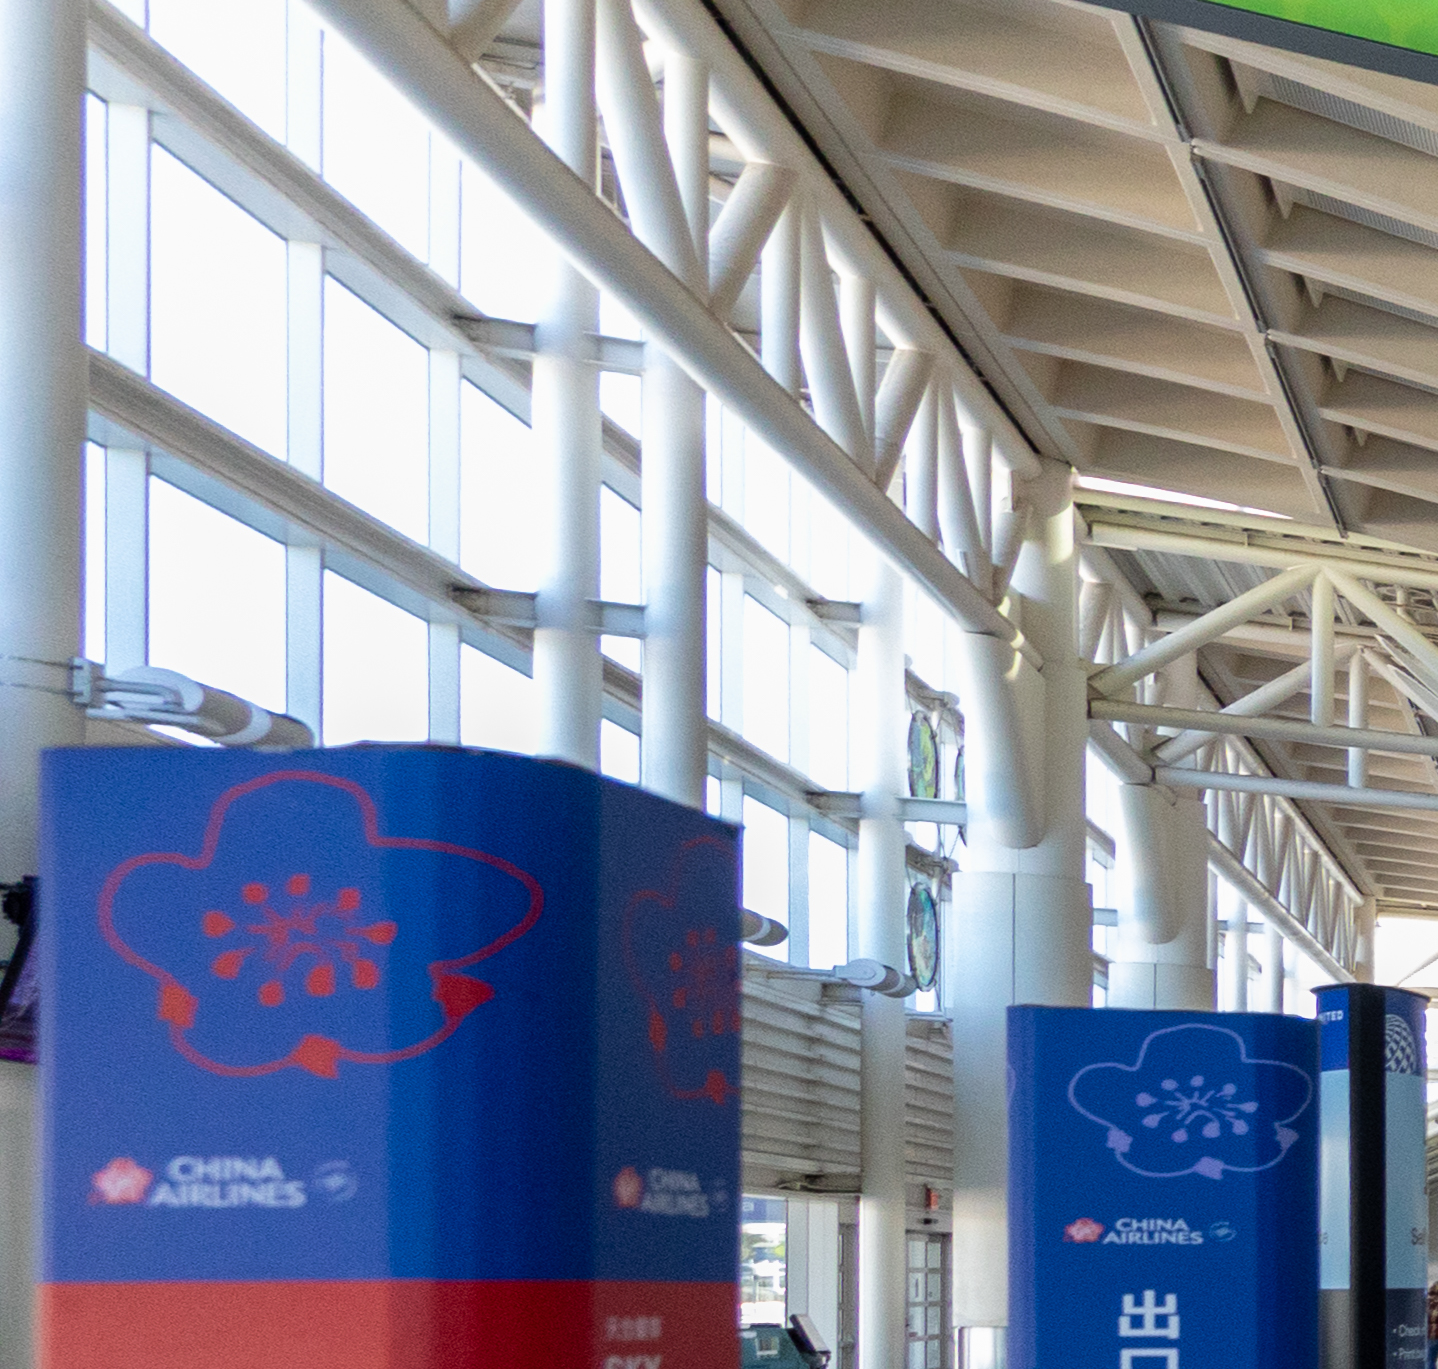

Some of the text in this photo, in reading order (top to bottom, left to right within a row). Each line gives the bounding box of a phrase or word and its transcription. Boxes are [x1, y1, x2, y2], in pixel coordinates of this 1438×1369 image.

[151, 1155, 308, 1208] CHINA AIRLINES
[1102, 1217, 1205, 1246] CHINA AIRLINES
